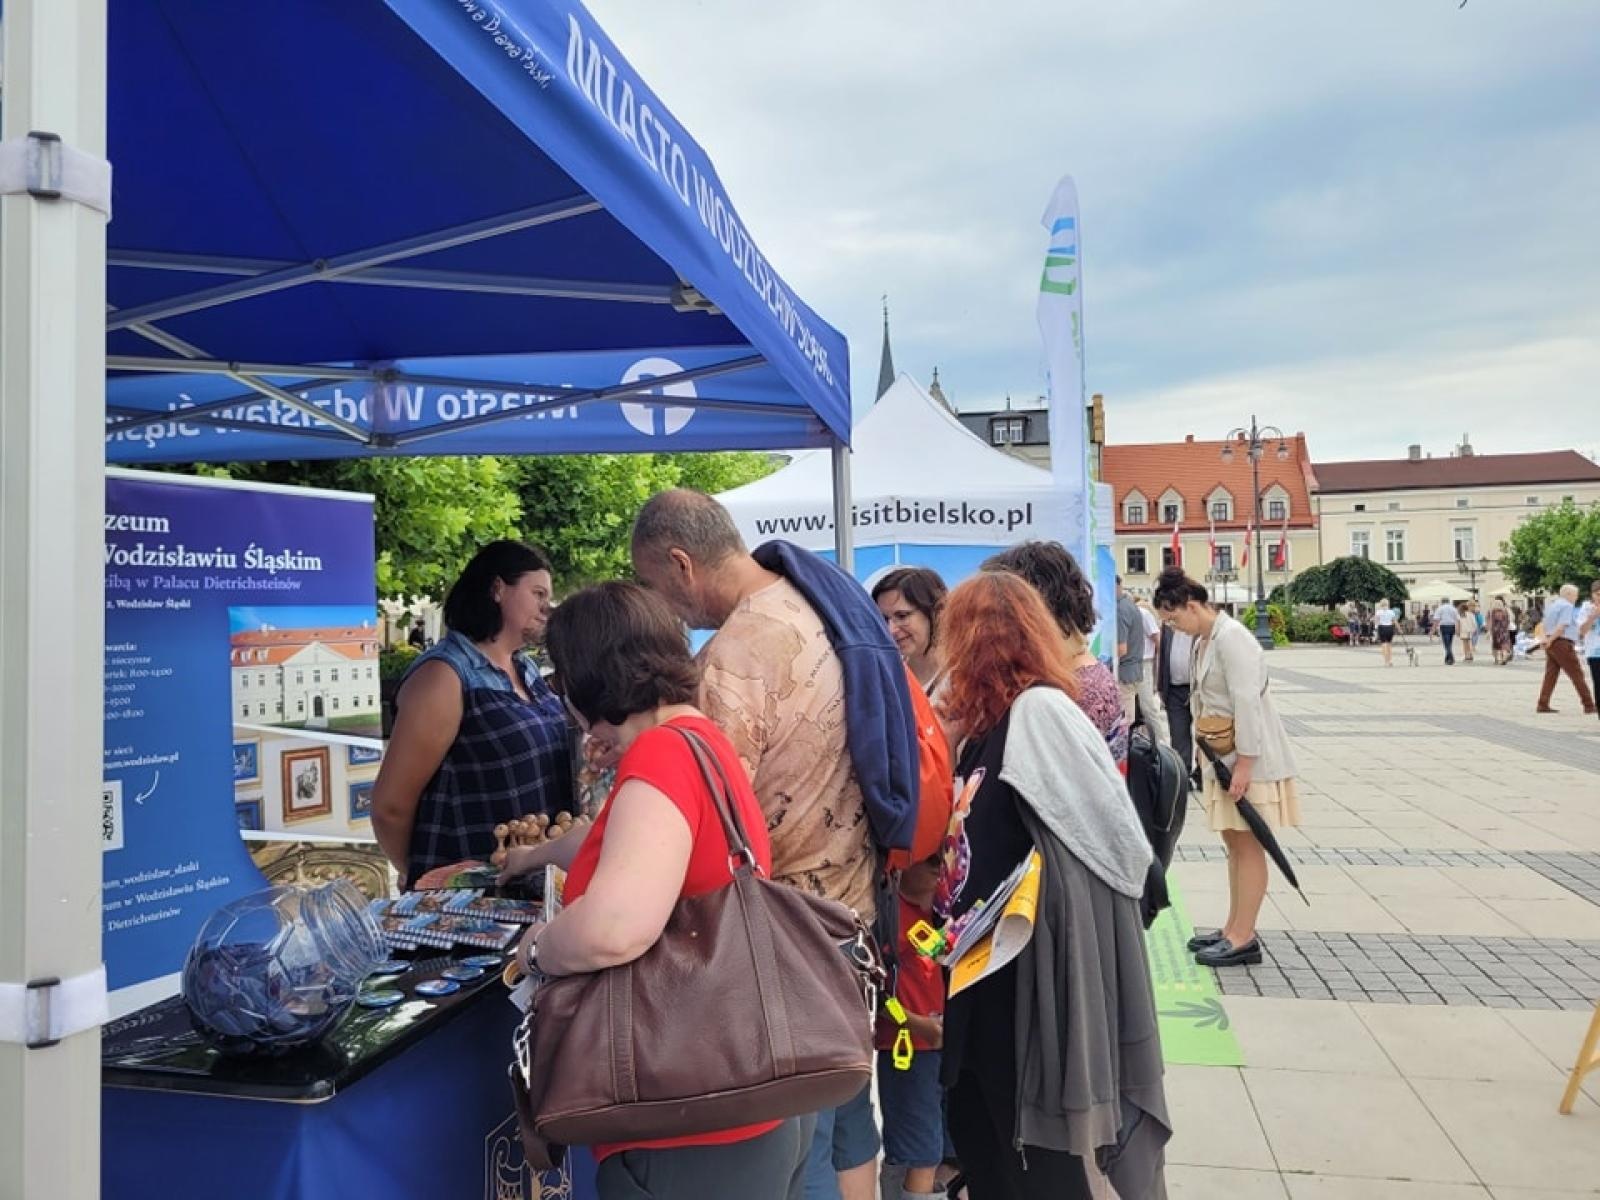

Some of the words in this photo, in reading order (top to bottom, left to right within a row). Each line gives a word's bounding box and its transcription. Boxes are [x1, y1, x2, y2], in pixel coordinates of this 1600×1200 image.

[566, 12, 690, 207] MIASTO
[756, 501, 1033, 535] www.isitbielsko.pl
[244, 542, 322, 575] Śląskim
[104, 574, 131, 592] ibą
[136, 578, 150, 588] w
